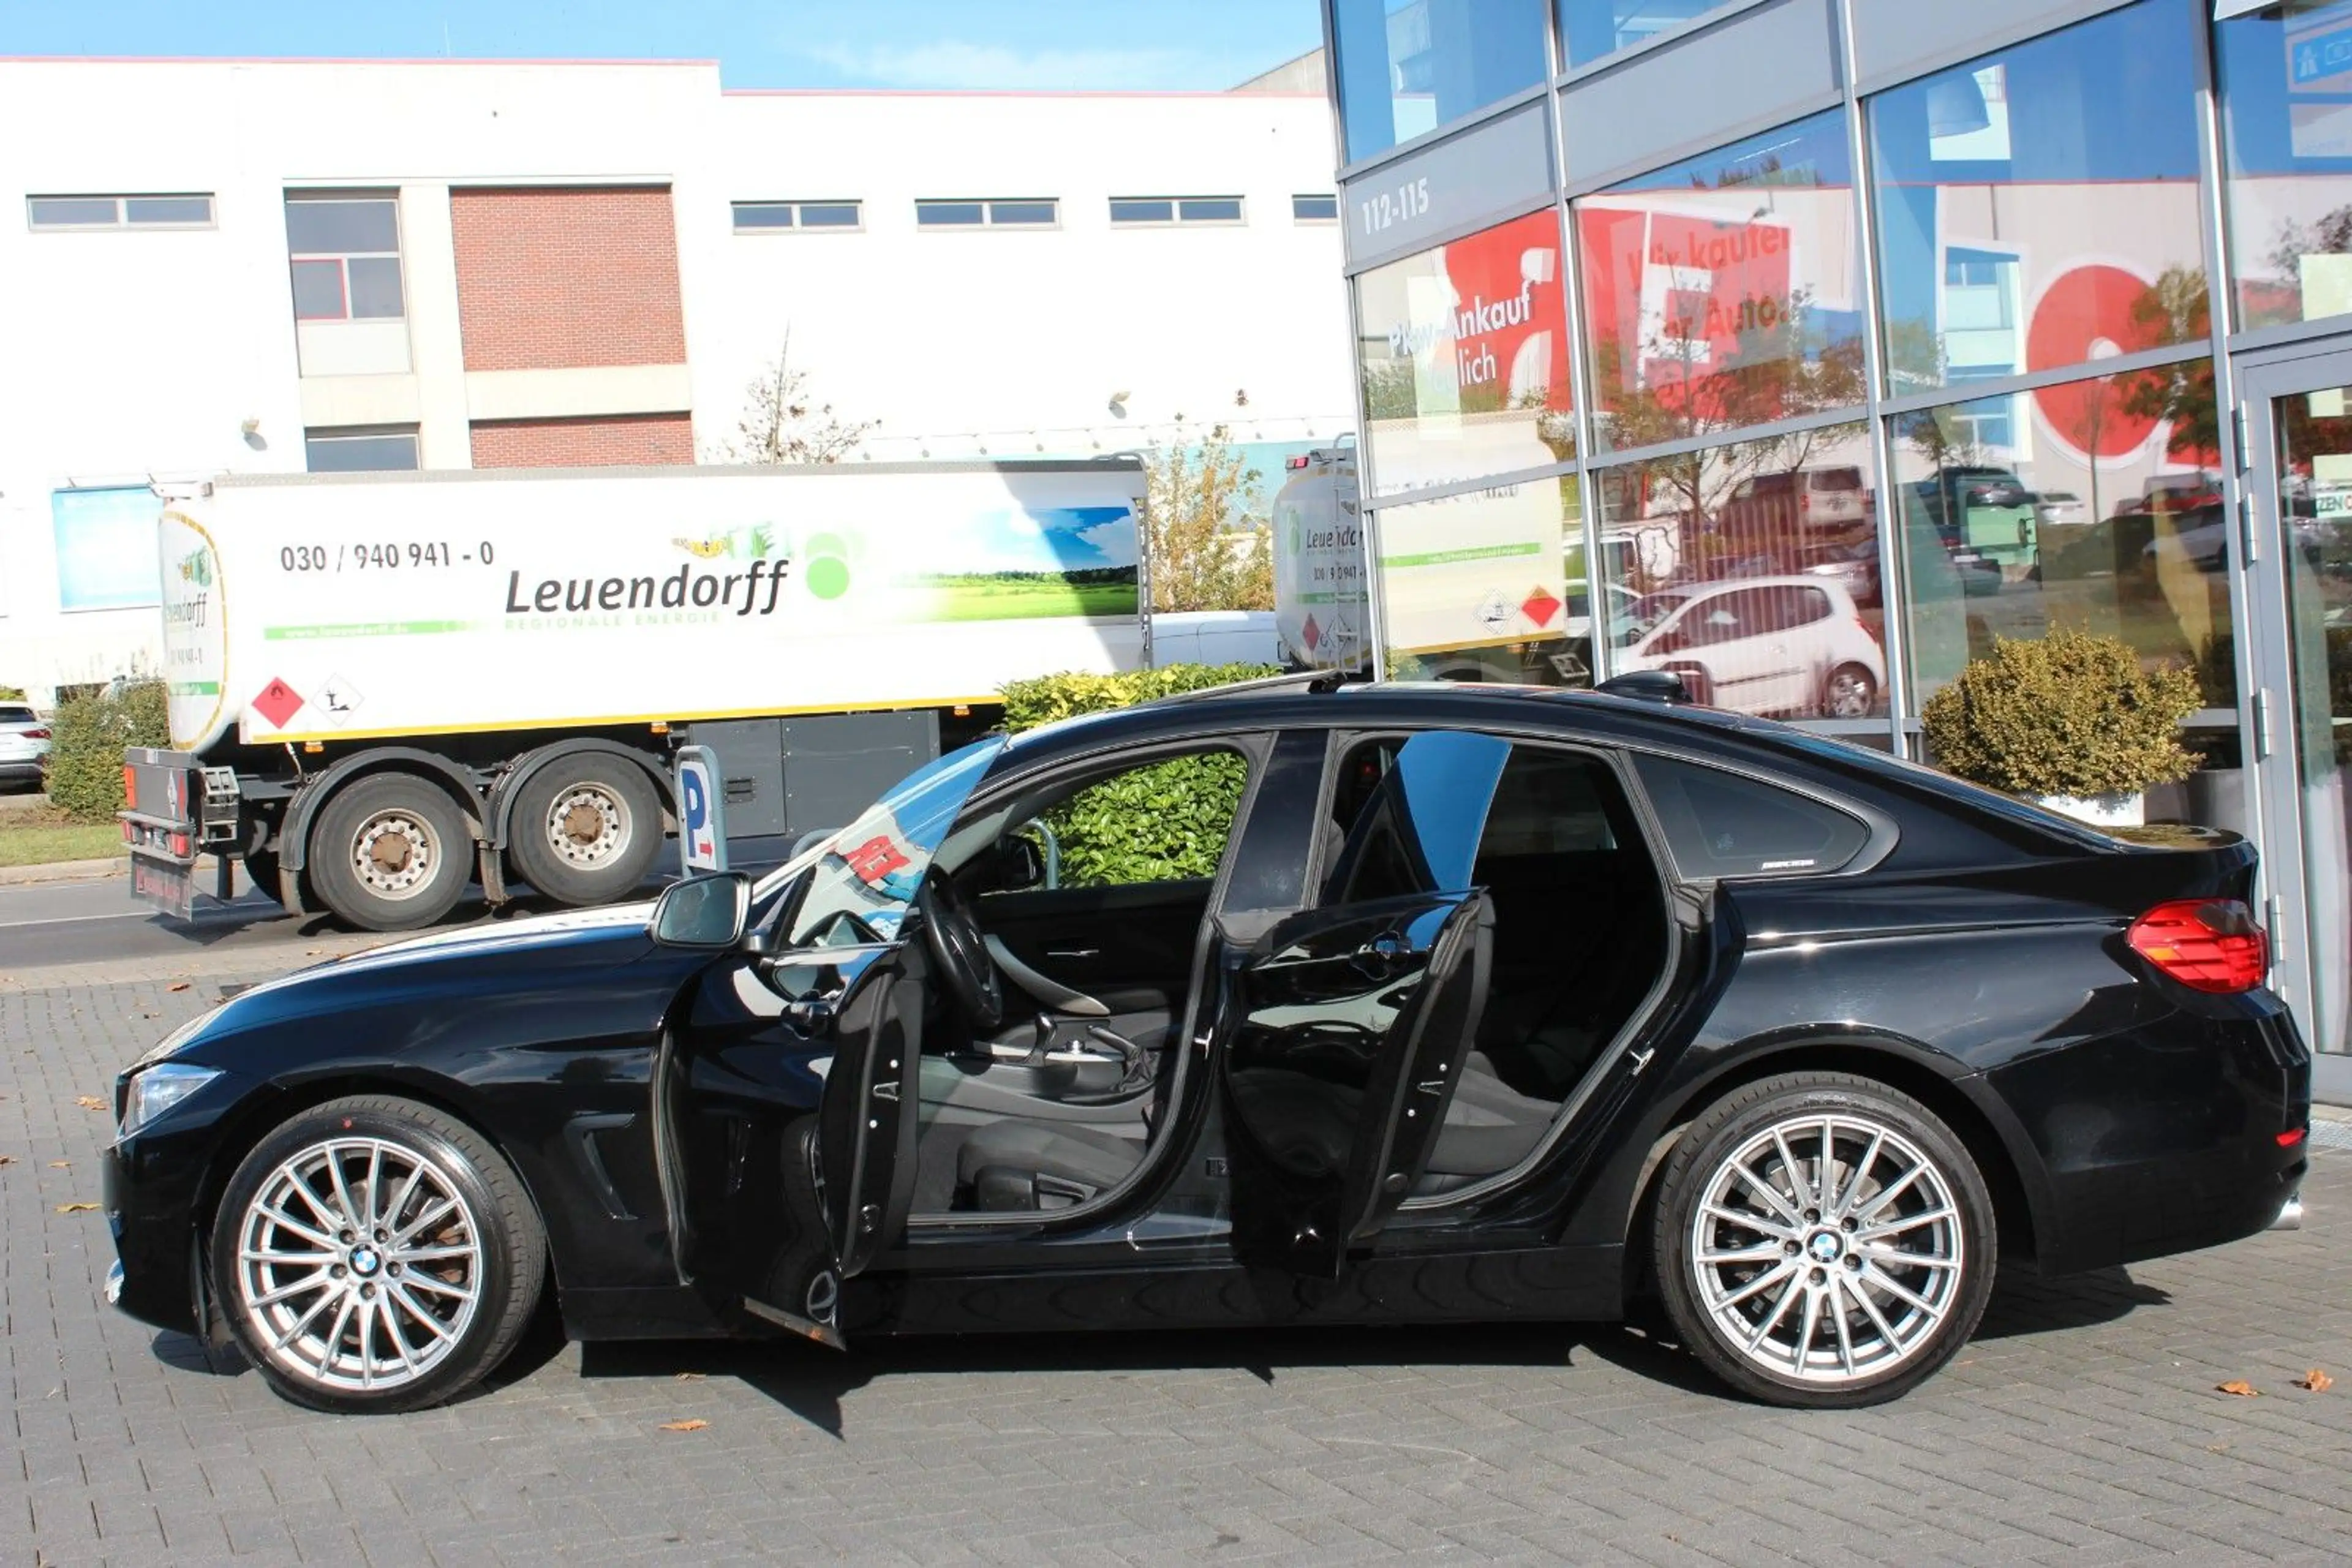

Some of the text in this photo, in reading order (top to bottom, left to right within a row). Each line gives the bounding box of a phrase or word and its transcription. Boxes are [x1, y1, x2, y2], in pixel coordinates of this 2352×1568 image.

[1362, 176, 1428, 235] 112-115
[281, 546, 326, 571] 030
[354, 543, 399, 570] 940
[408, 541, 450, 568] 941
[480, 540, 494, 565] 0
[505, 559, 789, 616] Leuendorff
[505, 611, 720, 630] REGIONALE ENERGIE
